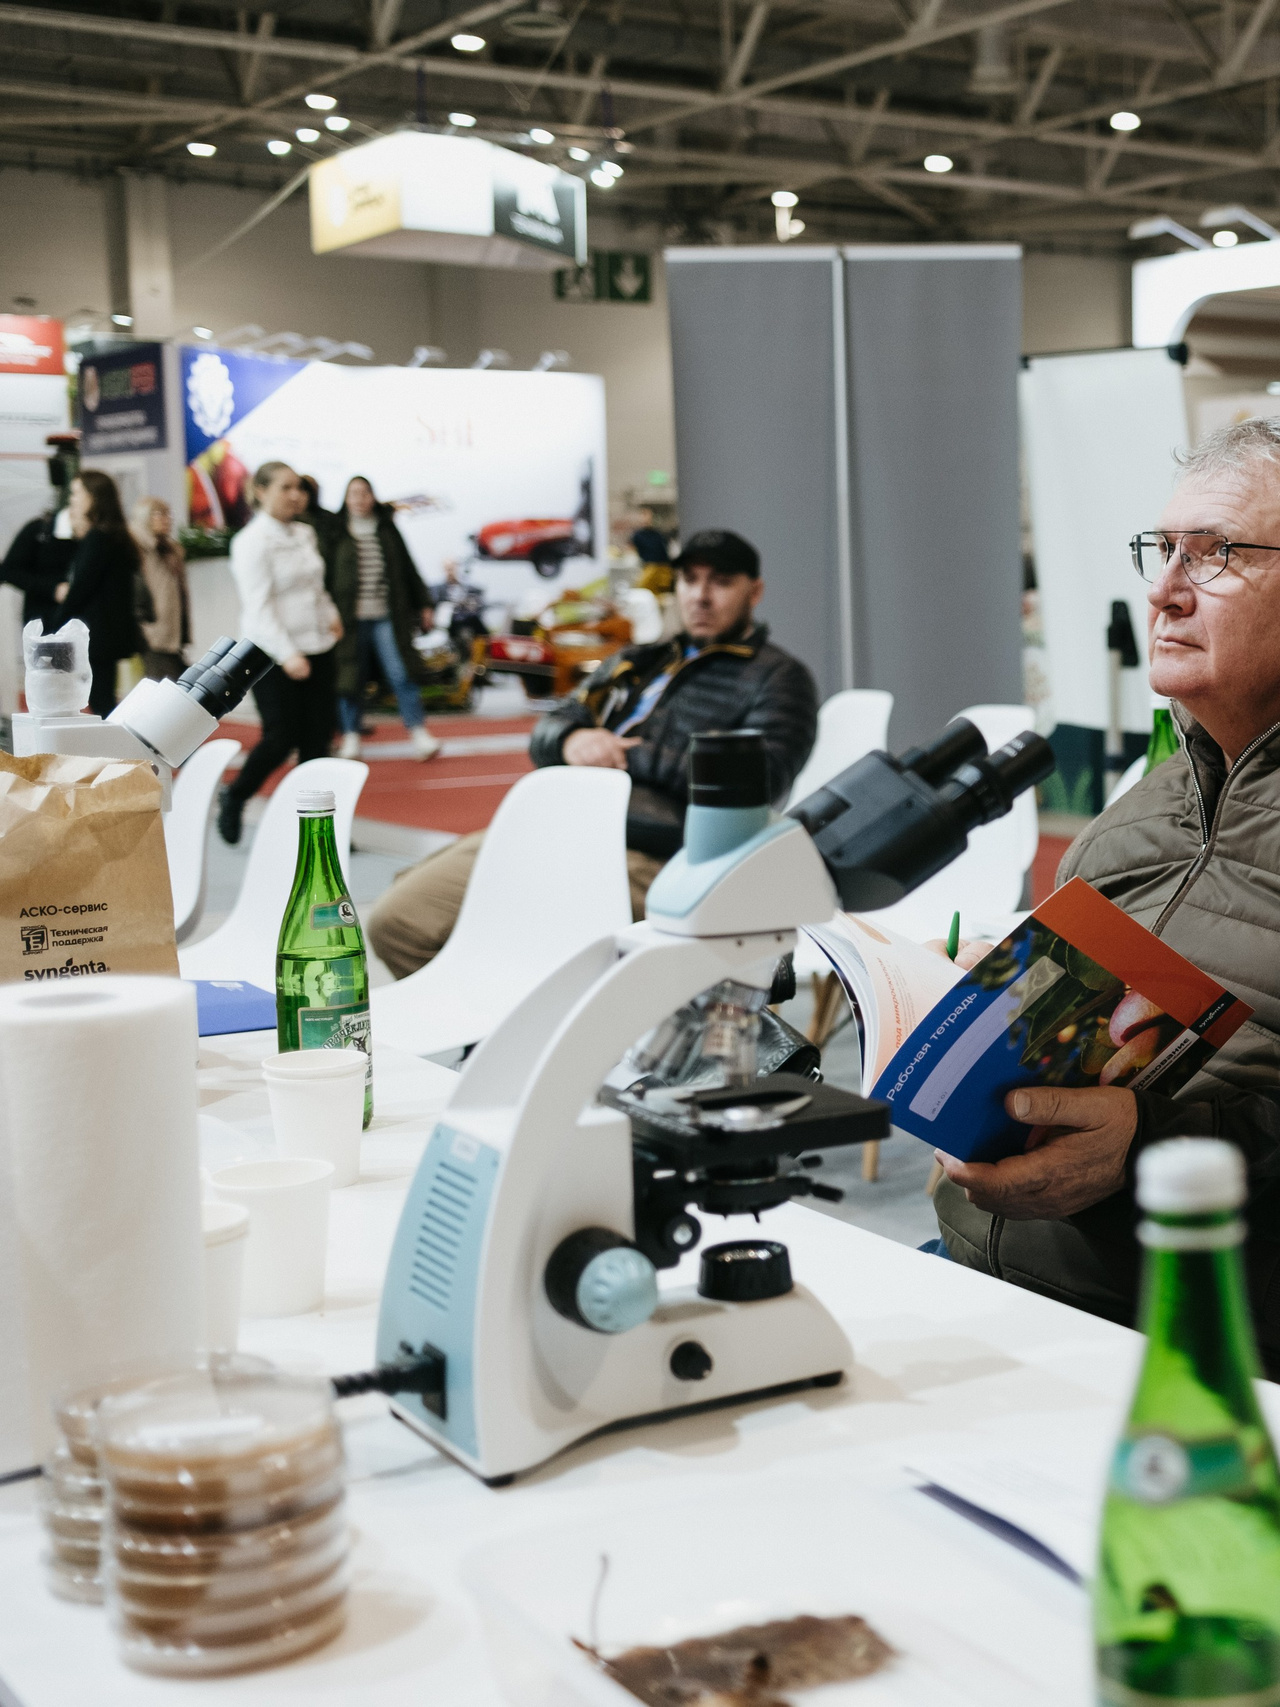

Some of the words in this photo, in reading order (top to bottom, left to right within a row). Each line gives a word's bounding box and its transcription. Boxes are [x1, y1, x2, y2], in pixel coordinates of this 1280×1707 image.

[20, 902, 108, 918] АСКО-сервис
[50, 926, 108, 937] Техническая
[52, 936, 104, 947] поддержка
[886, 1042, 932, 1101] Рабочая
[929, 991, 978, 1041] тетрадь
[1132, 1037, 1190, 1091] бразование
